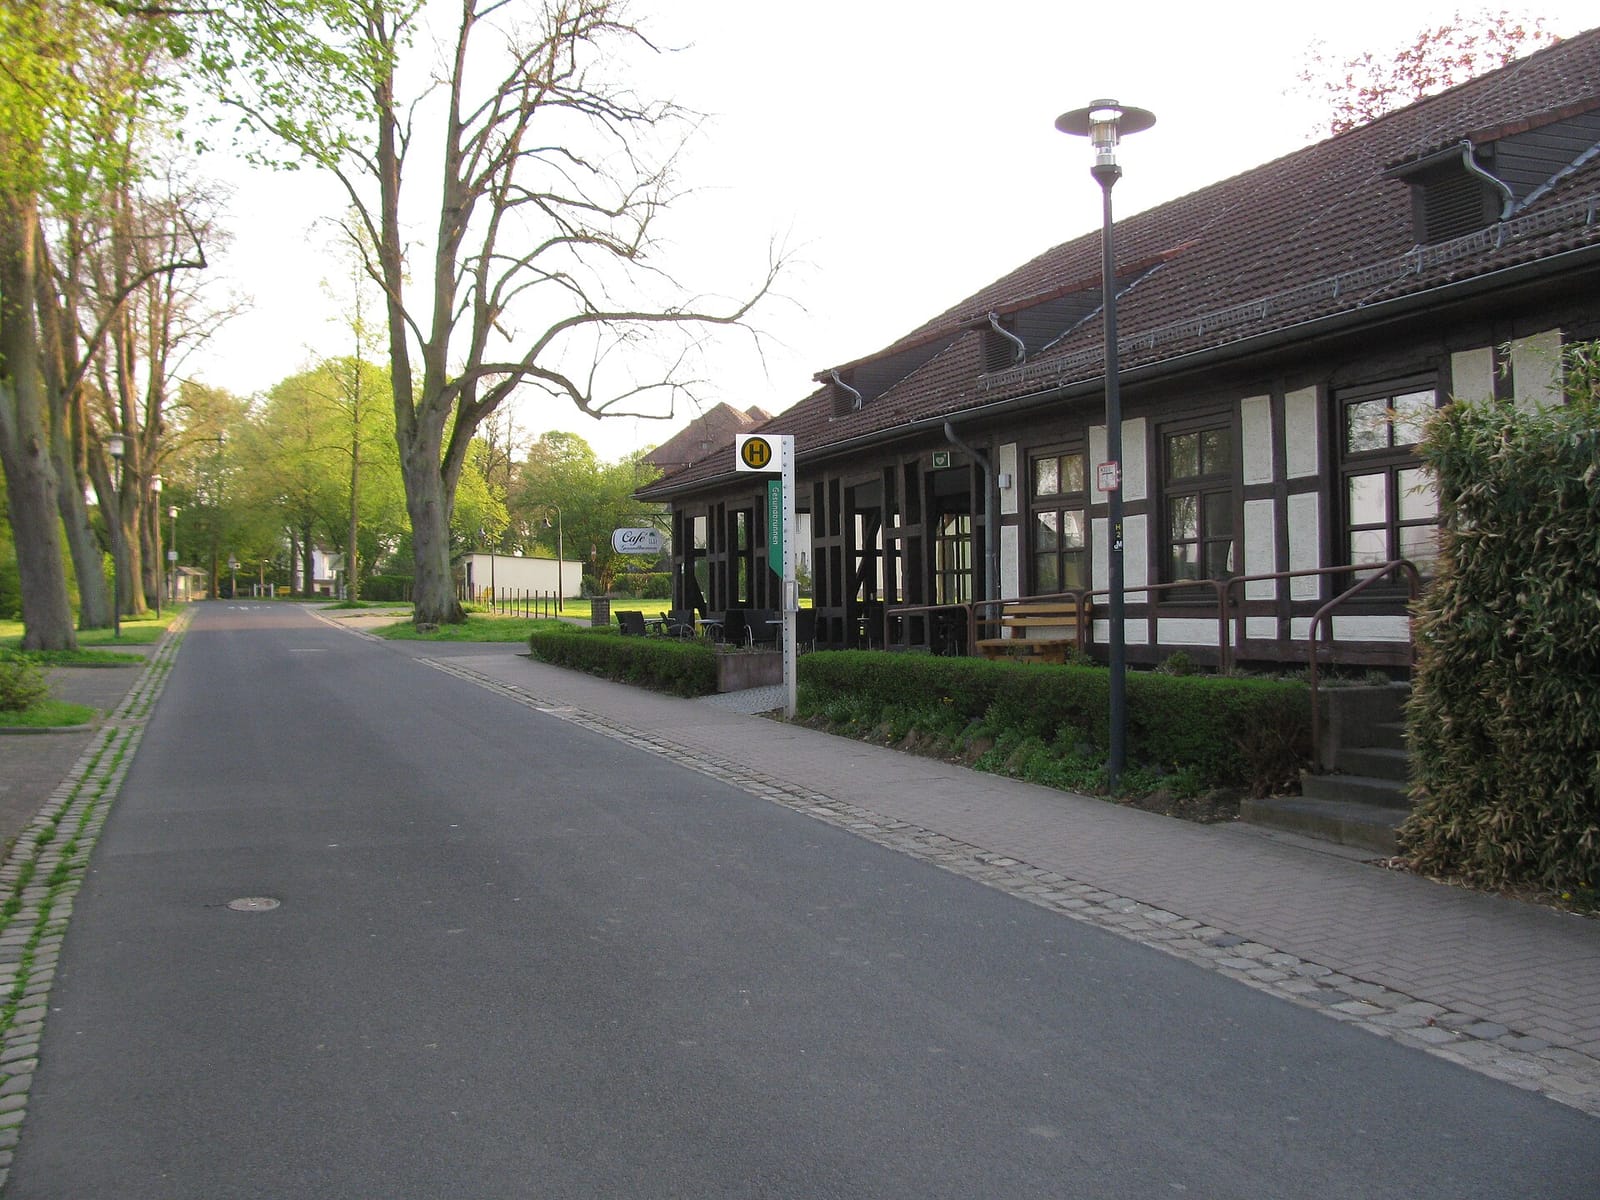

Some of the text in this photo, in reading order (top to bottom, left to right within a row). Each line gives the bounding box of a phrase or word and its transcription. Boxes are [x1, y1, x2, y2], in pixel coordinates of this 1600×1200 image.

[749, 443, 764, 462] H
[772, 487, 780, 545] Gesundbrunnen
[622, 530, 648, 546] Café
